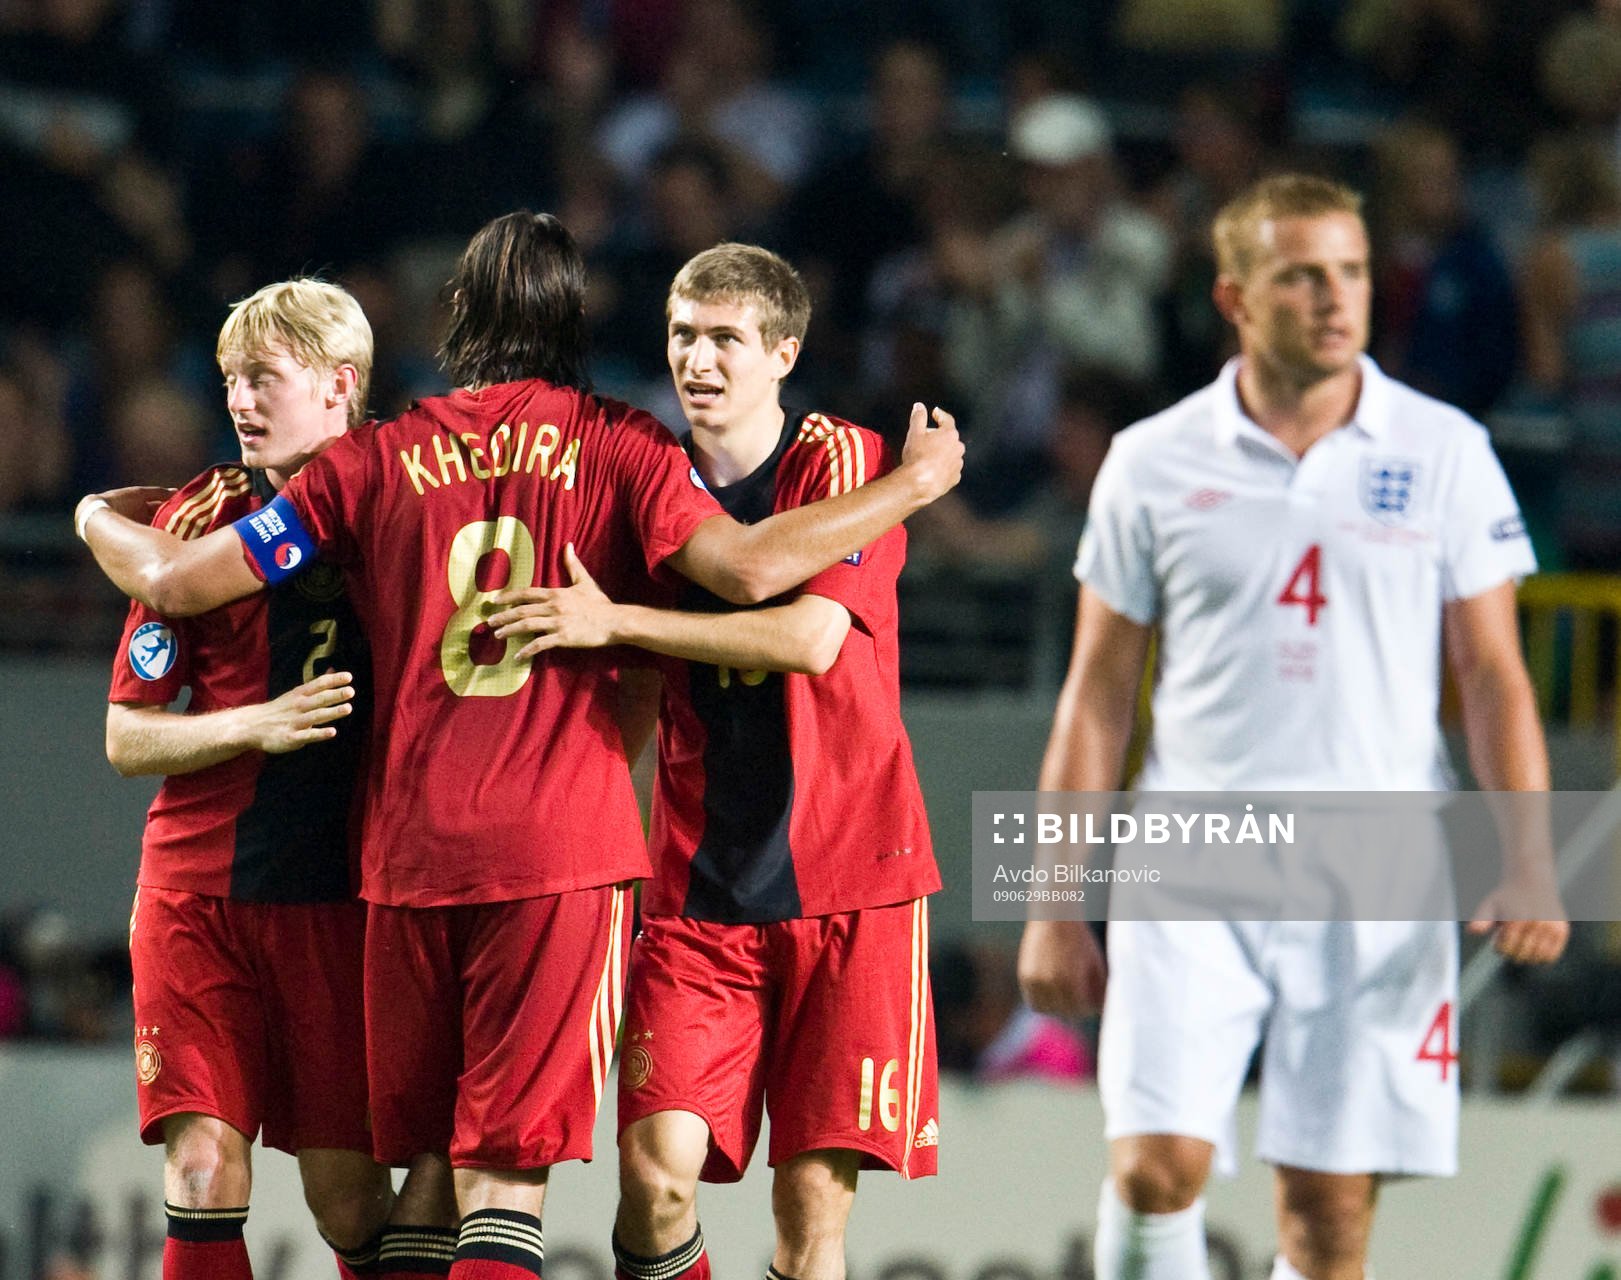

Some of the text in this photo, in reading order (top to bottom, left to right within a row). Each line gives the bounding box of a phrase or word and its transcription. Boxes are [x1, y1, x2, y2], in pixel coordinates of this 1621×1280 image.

[400, 421, 580, 495] KHEDIRA
[249, 516, 272, 544] UNITE
[441, 516, 535, 697] 8
[1277, 543, 1327, 627] 4
[303, 619, 337, 684] 2
[1416, 1002, 1459, 1082] 4
[859, 1057, 900, 1132] 16
